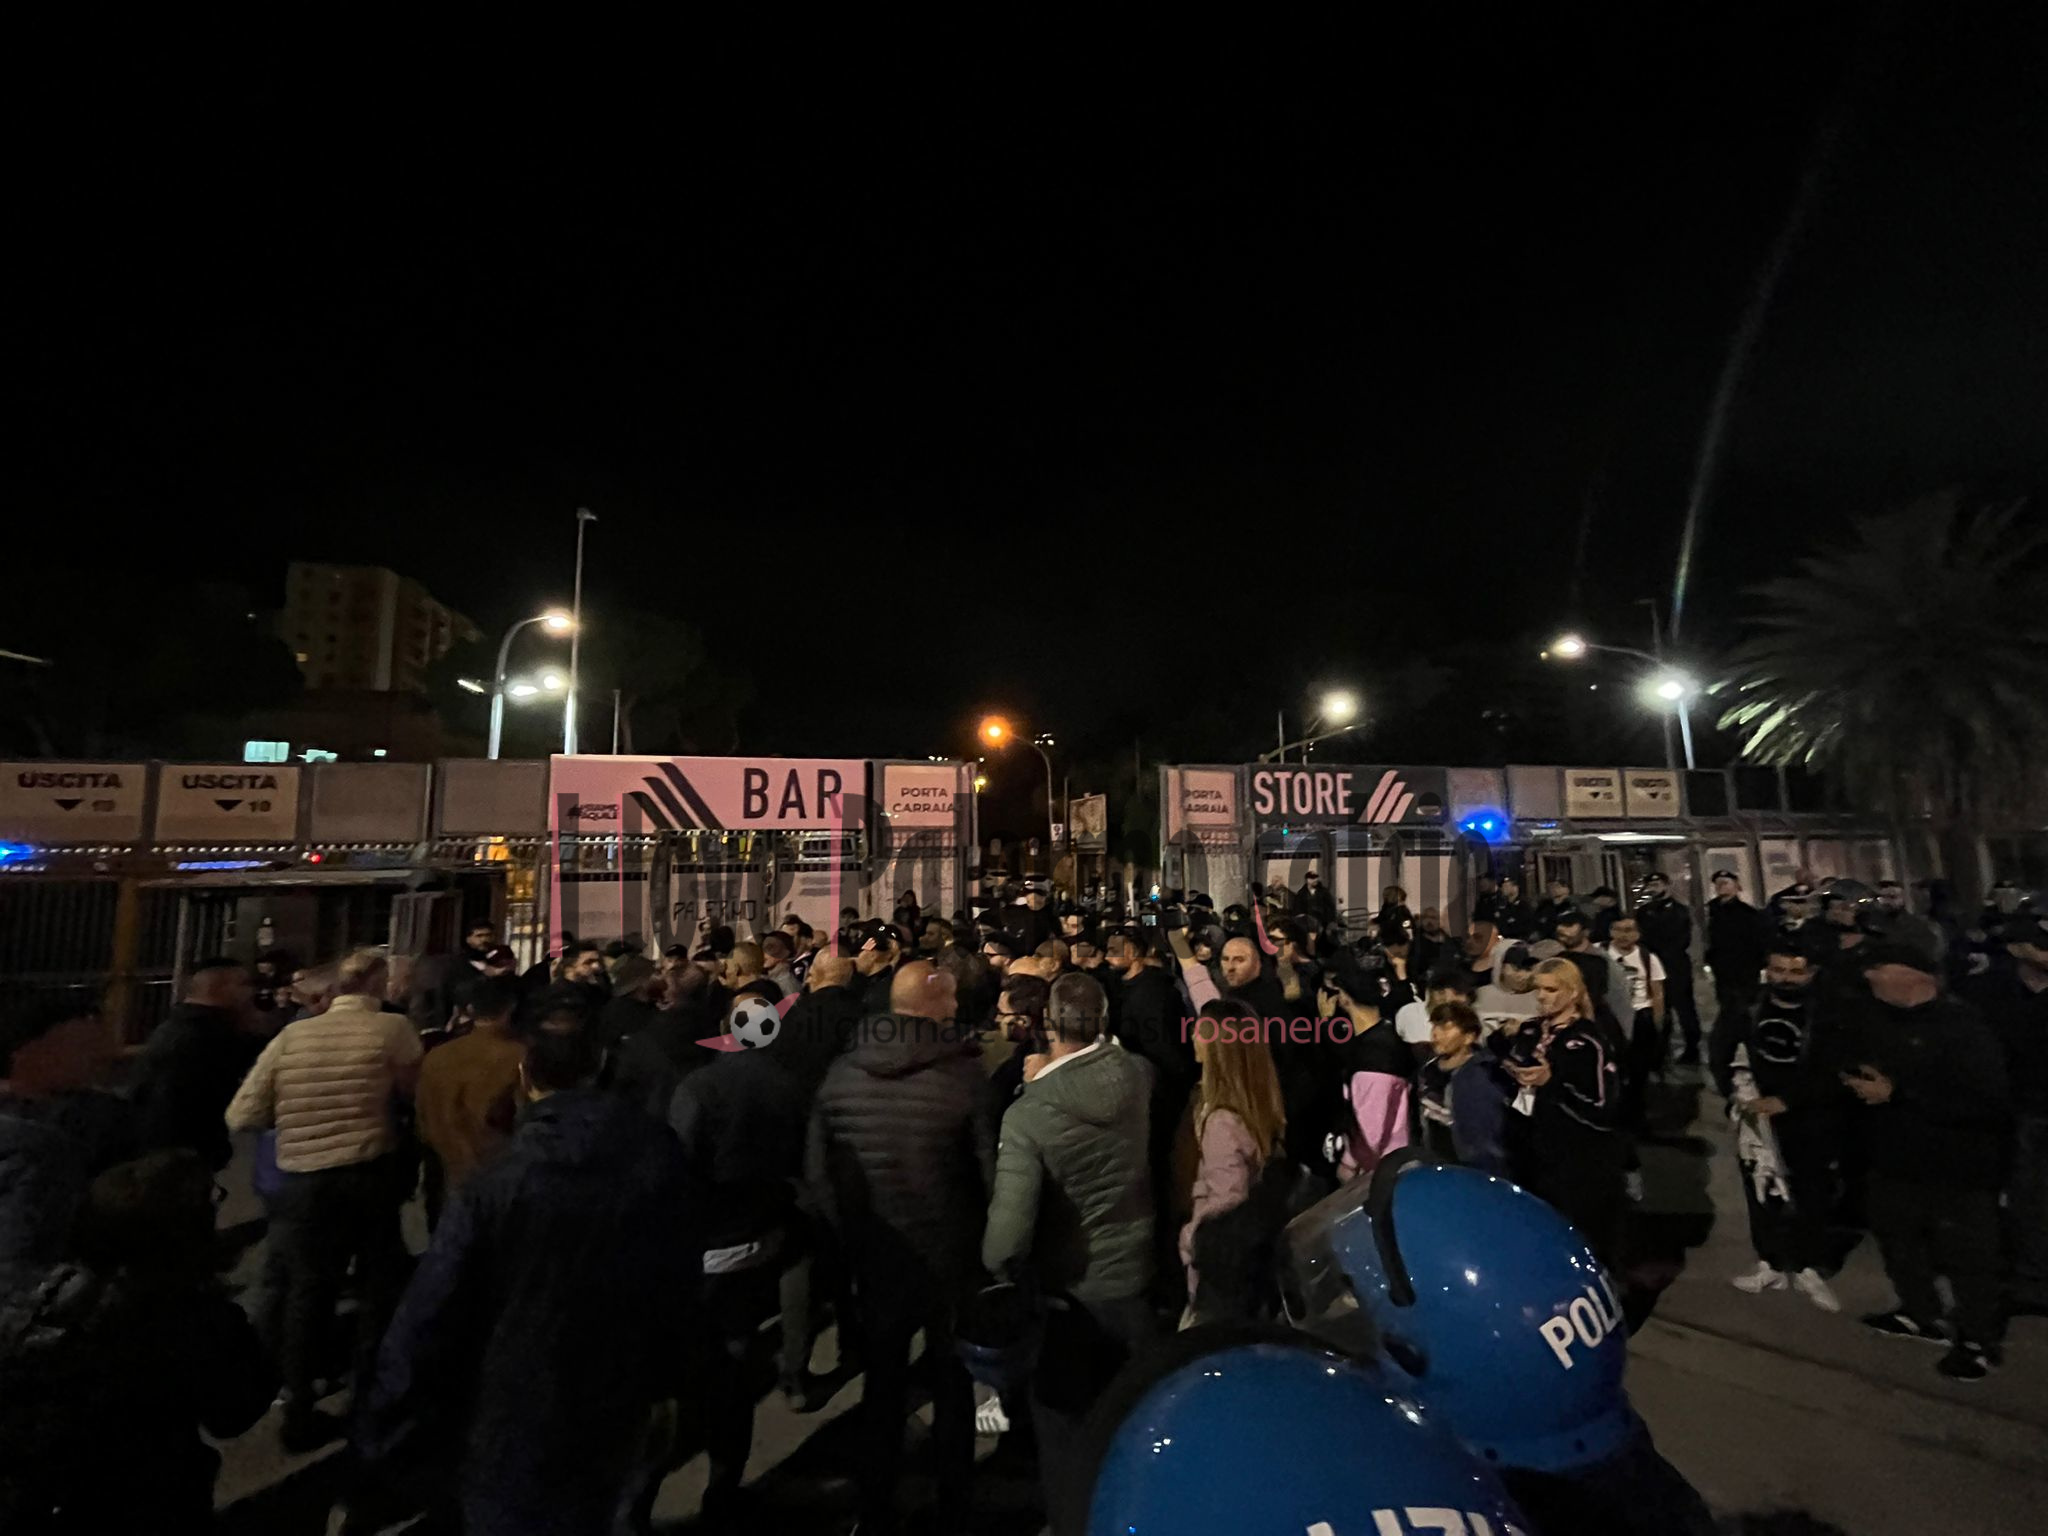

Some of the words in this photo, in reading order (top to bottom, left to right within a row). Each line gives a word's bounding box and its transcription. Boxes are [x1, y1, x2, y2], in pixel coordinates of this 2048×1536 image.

[17, 772, 123, 789] USCITA
[181, 774, 278, 790] USCITA
[742, 767, 843, 820] BAR
[900, 787, 948, 798] PORTA
[1184, 789, 1223, 799] PORTA
[1253, 771, 1355, 815] STORE
[892, 802, 959, 814] CARRAIA
[1185, 803, 1229, 814] ARRAIA
[672, 900, 757, 922] PALERMO
